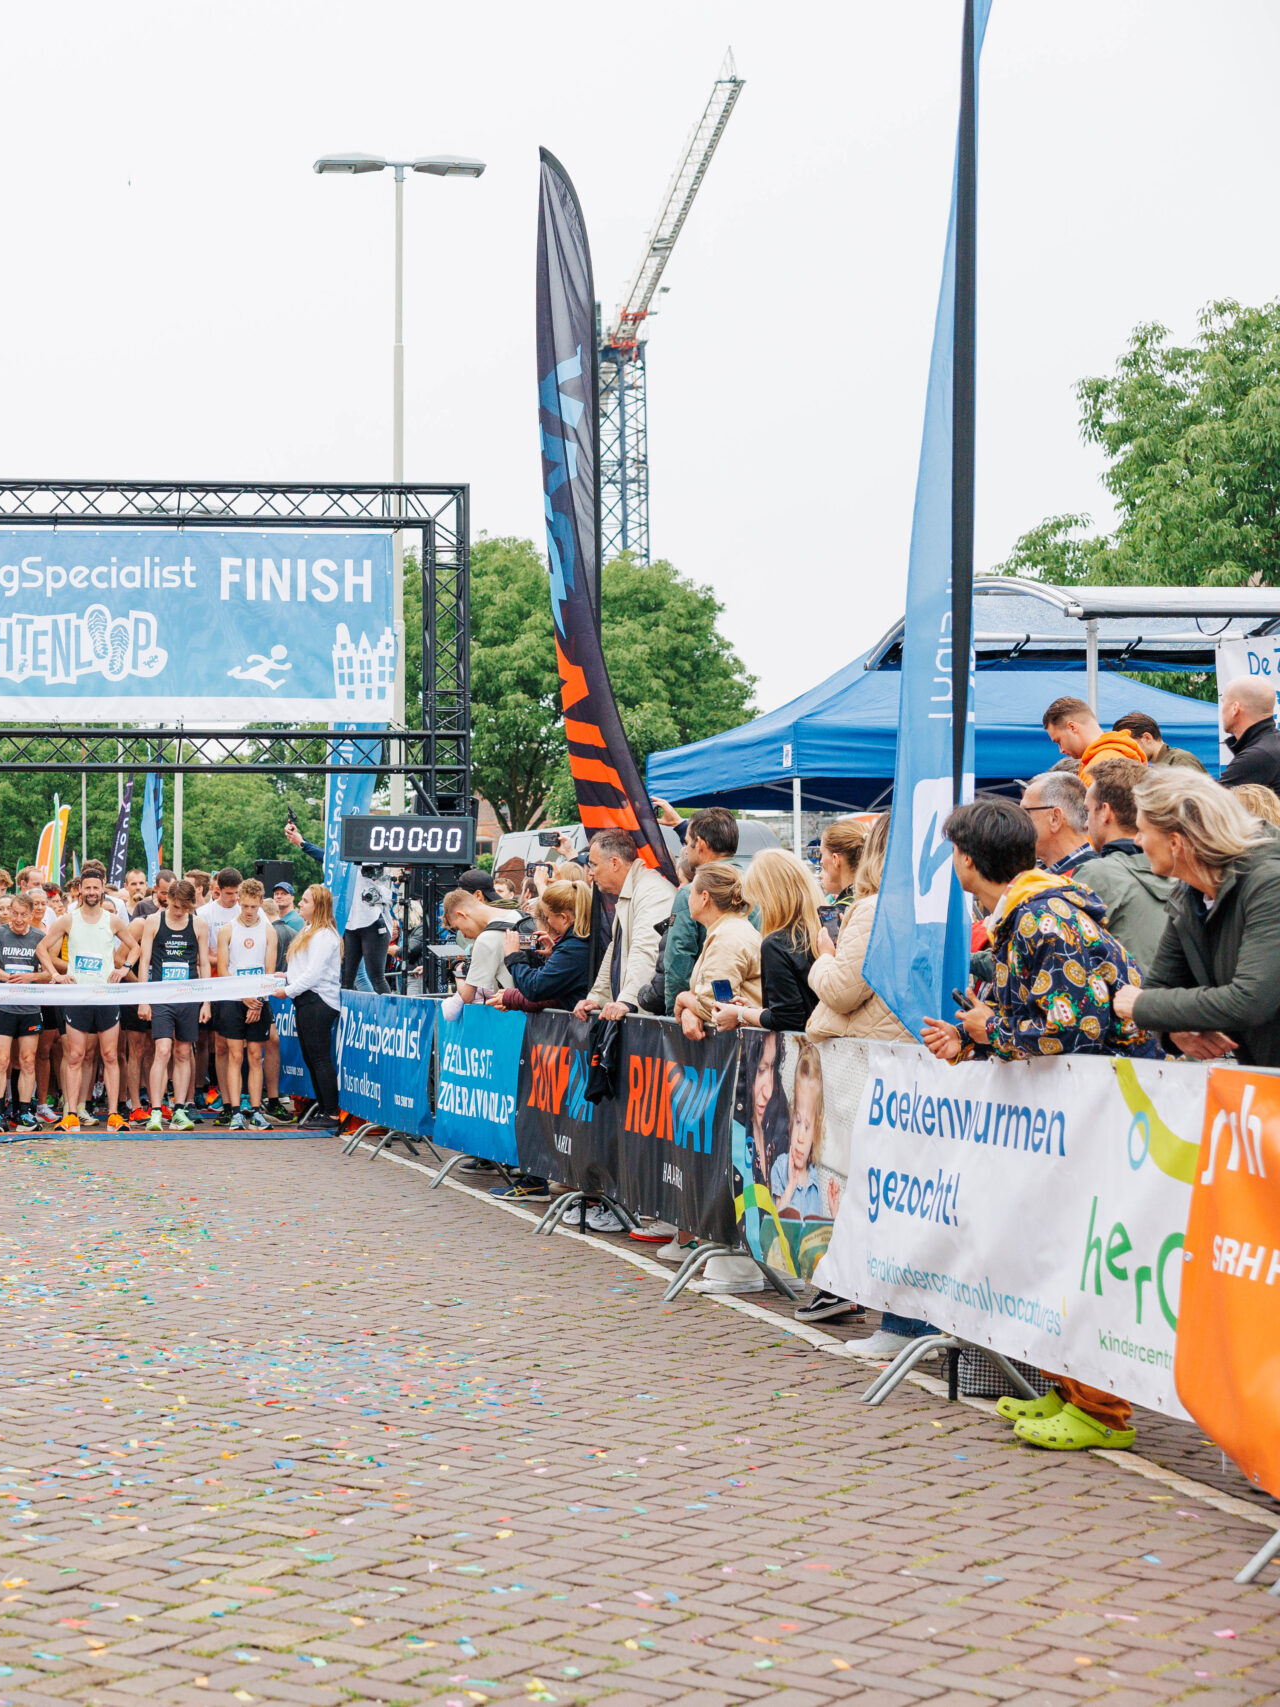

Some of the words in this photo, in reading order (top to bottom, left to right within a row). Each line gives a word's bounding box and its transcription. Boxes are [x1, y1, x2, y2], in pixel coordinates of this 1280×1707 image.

[221, 557, 373, 602] FINISH
[1247, 651, 1272, 676] De
[370, 826, 461, 852] 0:00:00
[77, 957, 101, 969] 6722
[164, 968, 187, 978] 5779
[868, 1078, 1066, 1157] Boekenwurmen
[868, 1166, 960, 1227] gezocht!
[1211, 1234, 1266, 1281] SRH
